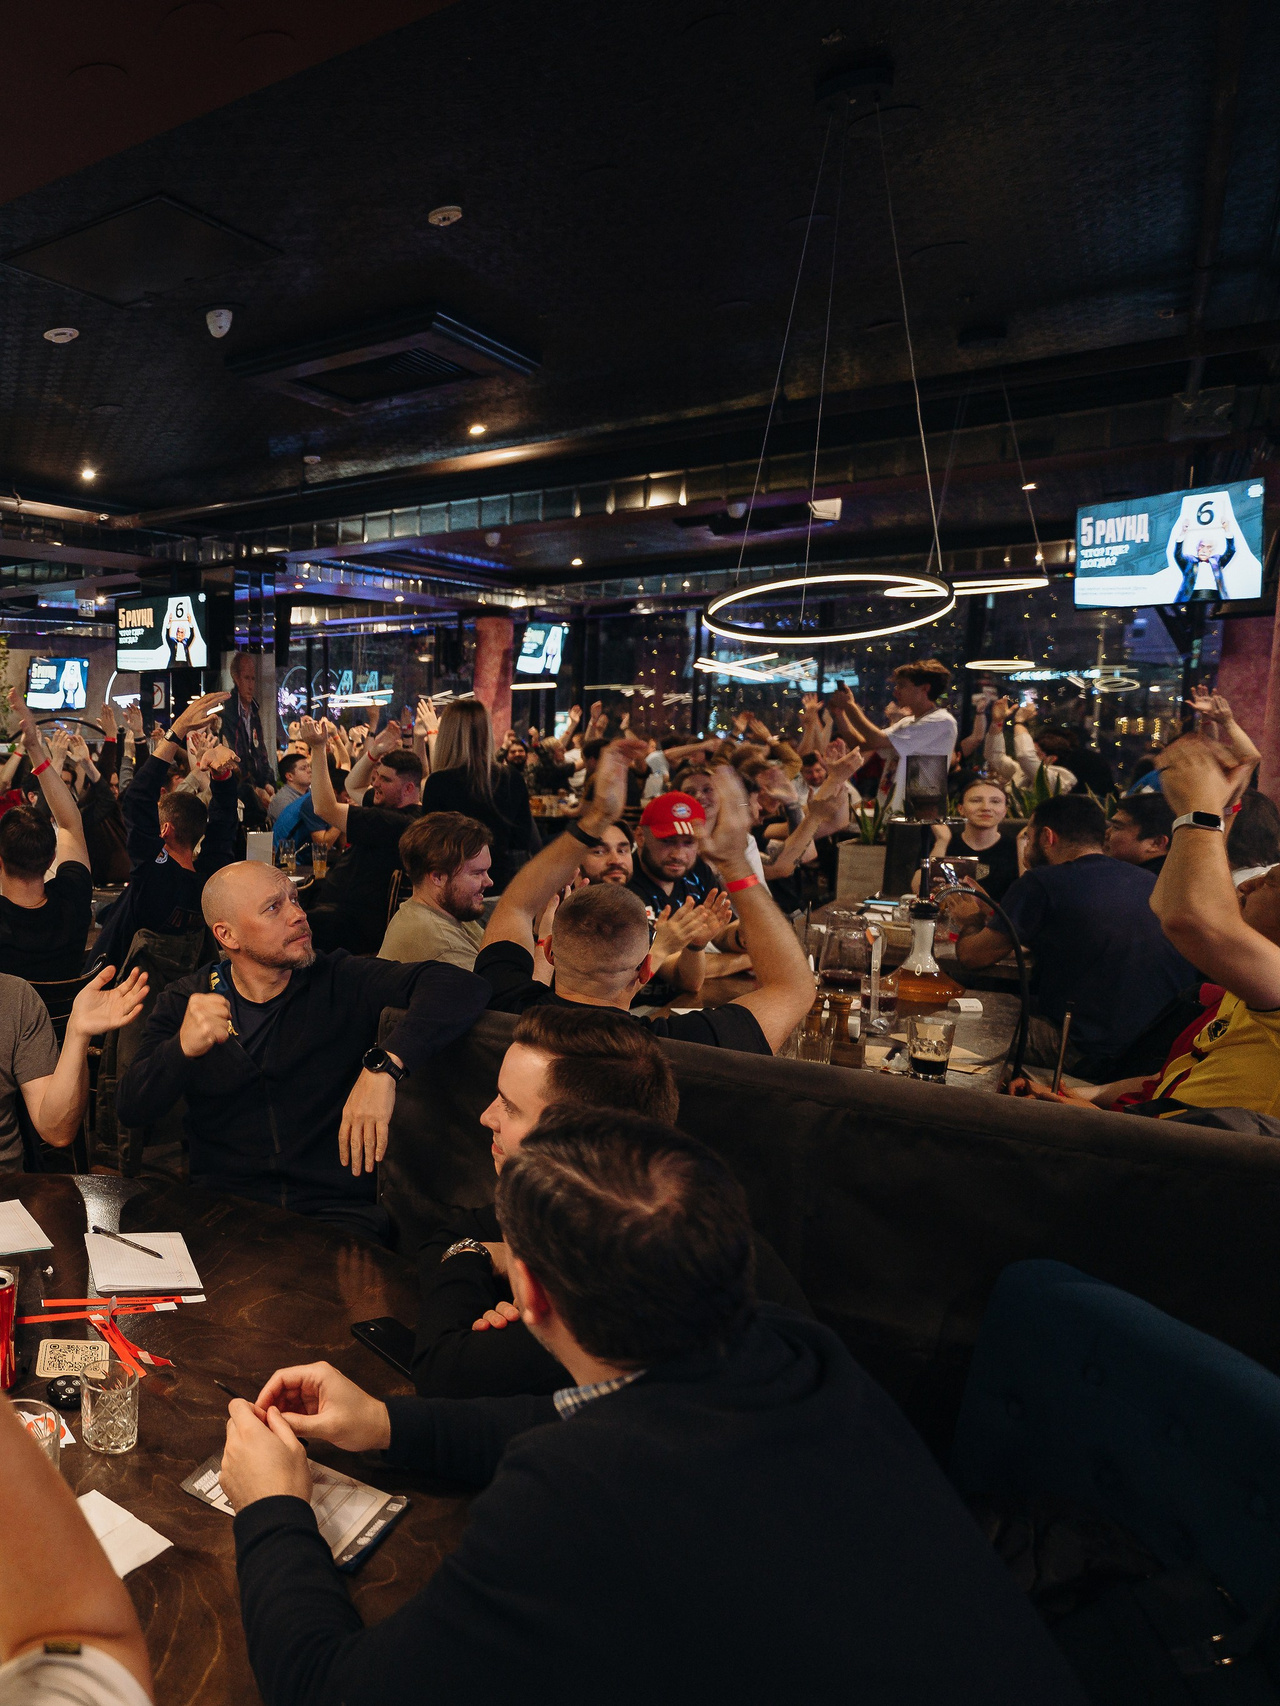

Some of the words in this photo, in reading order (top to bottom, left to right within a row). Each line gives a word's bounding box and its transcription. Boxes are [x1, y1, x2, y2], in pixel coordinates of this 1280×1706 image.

[1196, 501, 1215, 525] 6
[1081, 517, 1094, 546] 5
[1095, 513, 1150, 544] РАУНД
[118, 607, 126, 629] 5
[126, 607, 154, 629] РАУНД
[176, 602, 184, 618] 6
